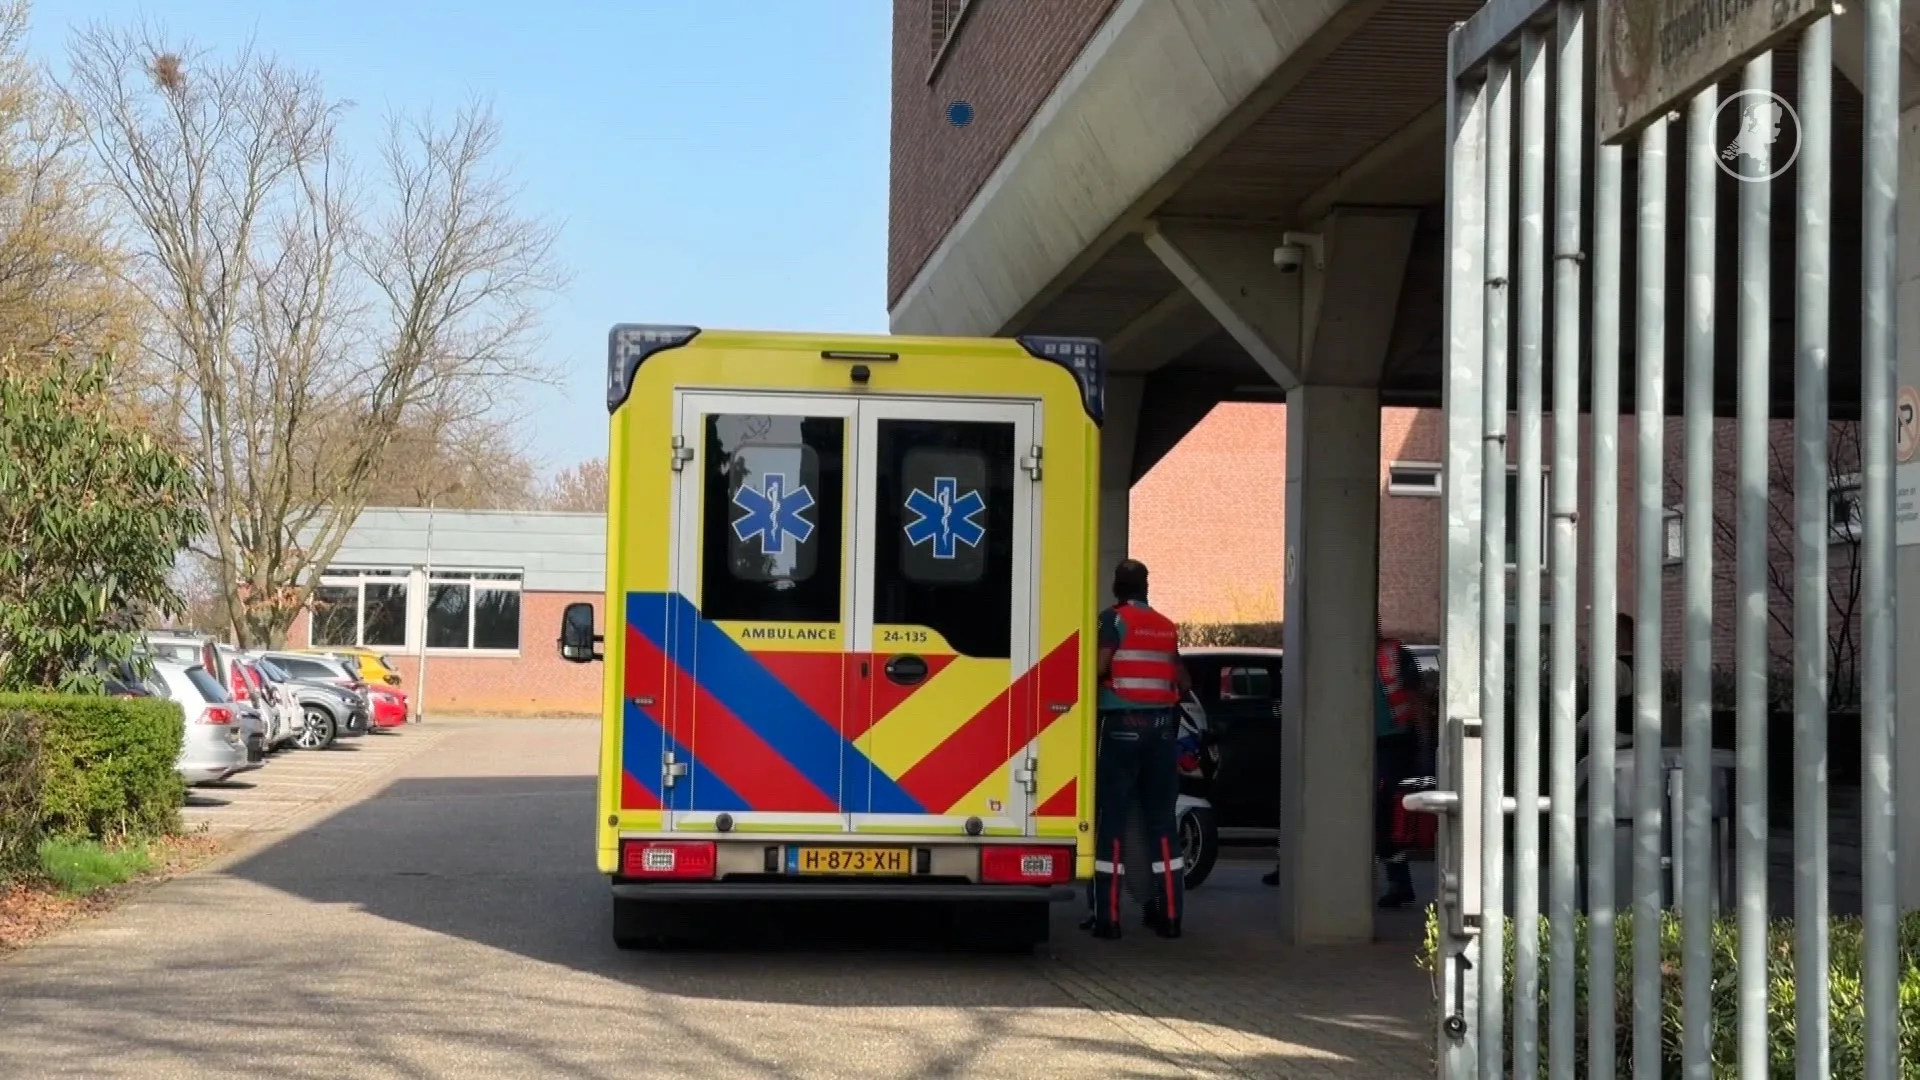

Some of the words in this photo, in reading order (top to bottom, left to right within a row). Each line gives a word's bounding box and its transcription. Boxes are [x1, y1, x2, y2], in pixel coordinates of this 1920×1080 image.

[741, 628, 837, 640] AMBULANCE
[884, 631, 927, 642] 24-135
[806, 850, 901, 870] H-873-XH
